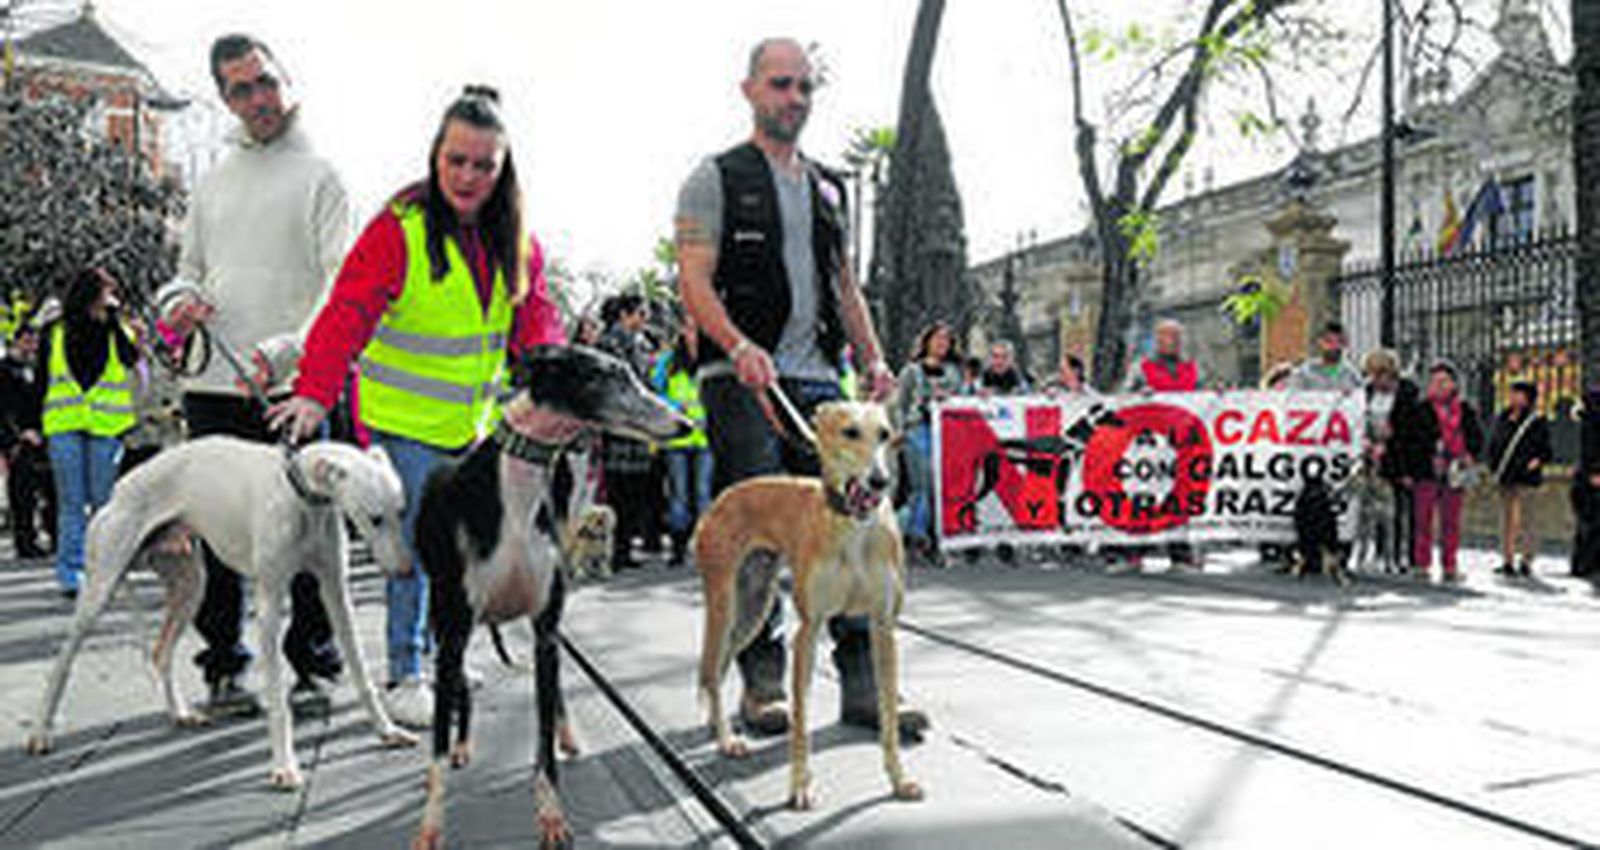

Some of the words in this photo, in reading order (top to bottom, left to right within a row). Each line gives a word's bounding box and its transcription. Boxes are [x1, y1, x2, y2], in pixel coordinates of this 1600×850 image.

[1135, 429, 1157, 447] A
[1170, 426, 1202, 448] LA
[1213, 409, 1352, 446] CAZA
[941, 403, 1214, 537] NO
[1113, 456, 1177, 482] CON
[1189, 451, 1351, 482] GALGOS
[1028, 501, 1043, 520] Y
[1075, 488, 1208, 520] OTRAS
[1215, 488, 1348, 517] RAZS
